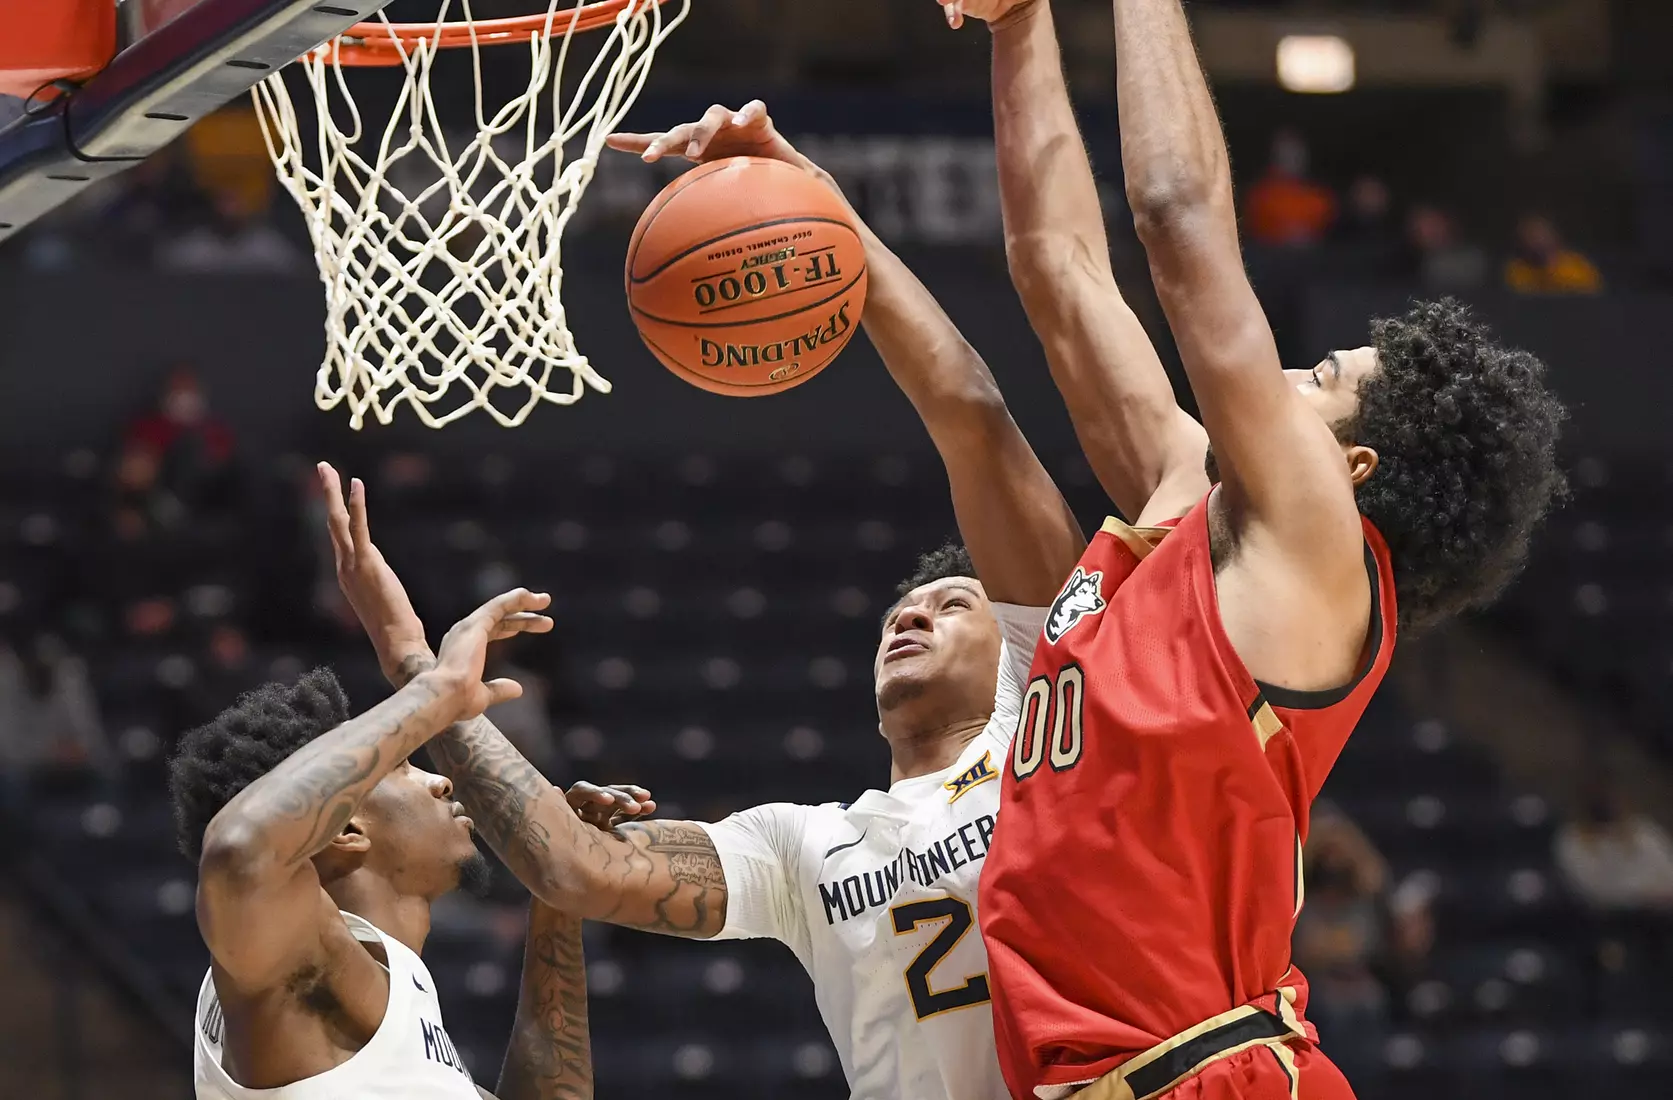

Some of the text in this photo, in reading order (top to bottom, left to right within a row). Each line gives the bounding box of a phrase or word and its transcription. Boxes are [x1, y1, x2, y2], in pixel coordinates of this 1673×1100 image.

[707, 230, 812, 261] DEEP CHANNEL DESIGN
[740, 245, 796, 271] LEGACY
[694, 251, 841, 308] TF-1000
[701, 301, 851, 367] SPALDING
[1012, 662, 1085, 783] 00
[944, 750, 998, 804] XII
[818, 812, 999, 925] MOUNTAINEER
[889, 895, 992, 1022] 2
